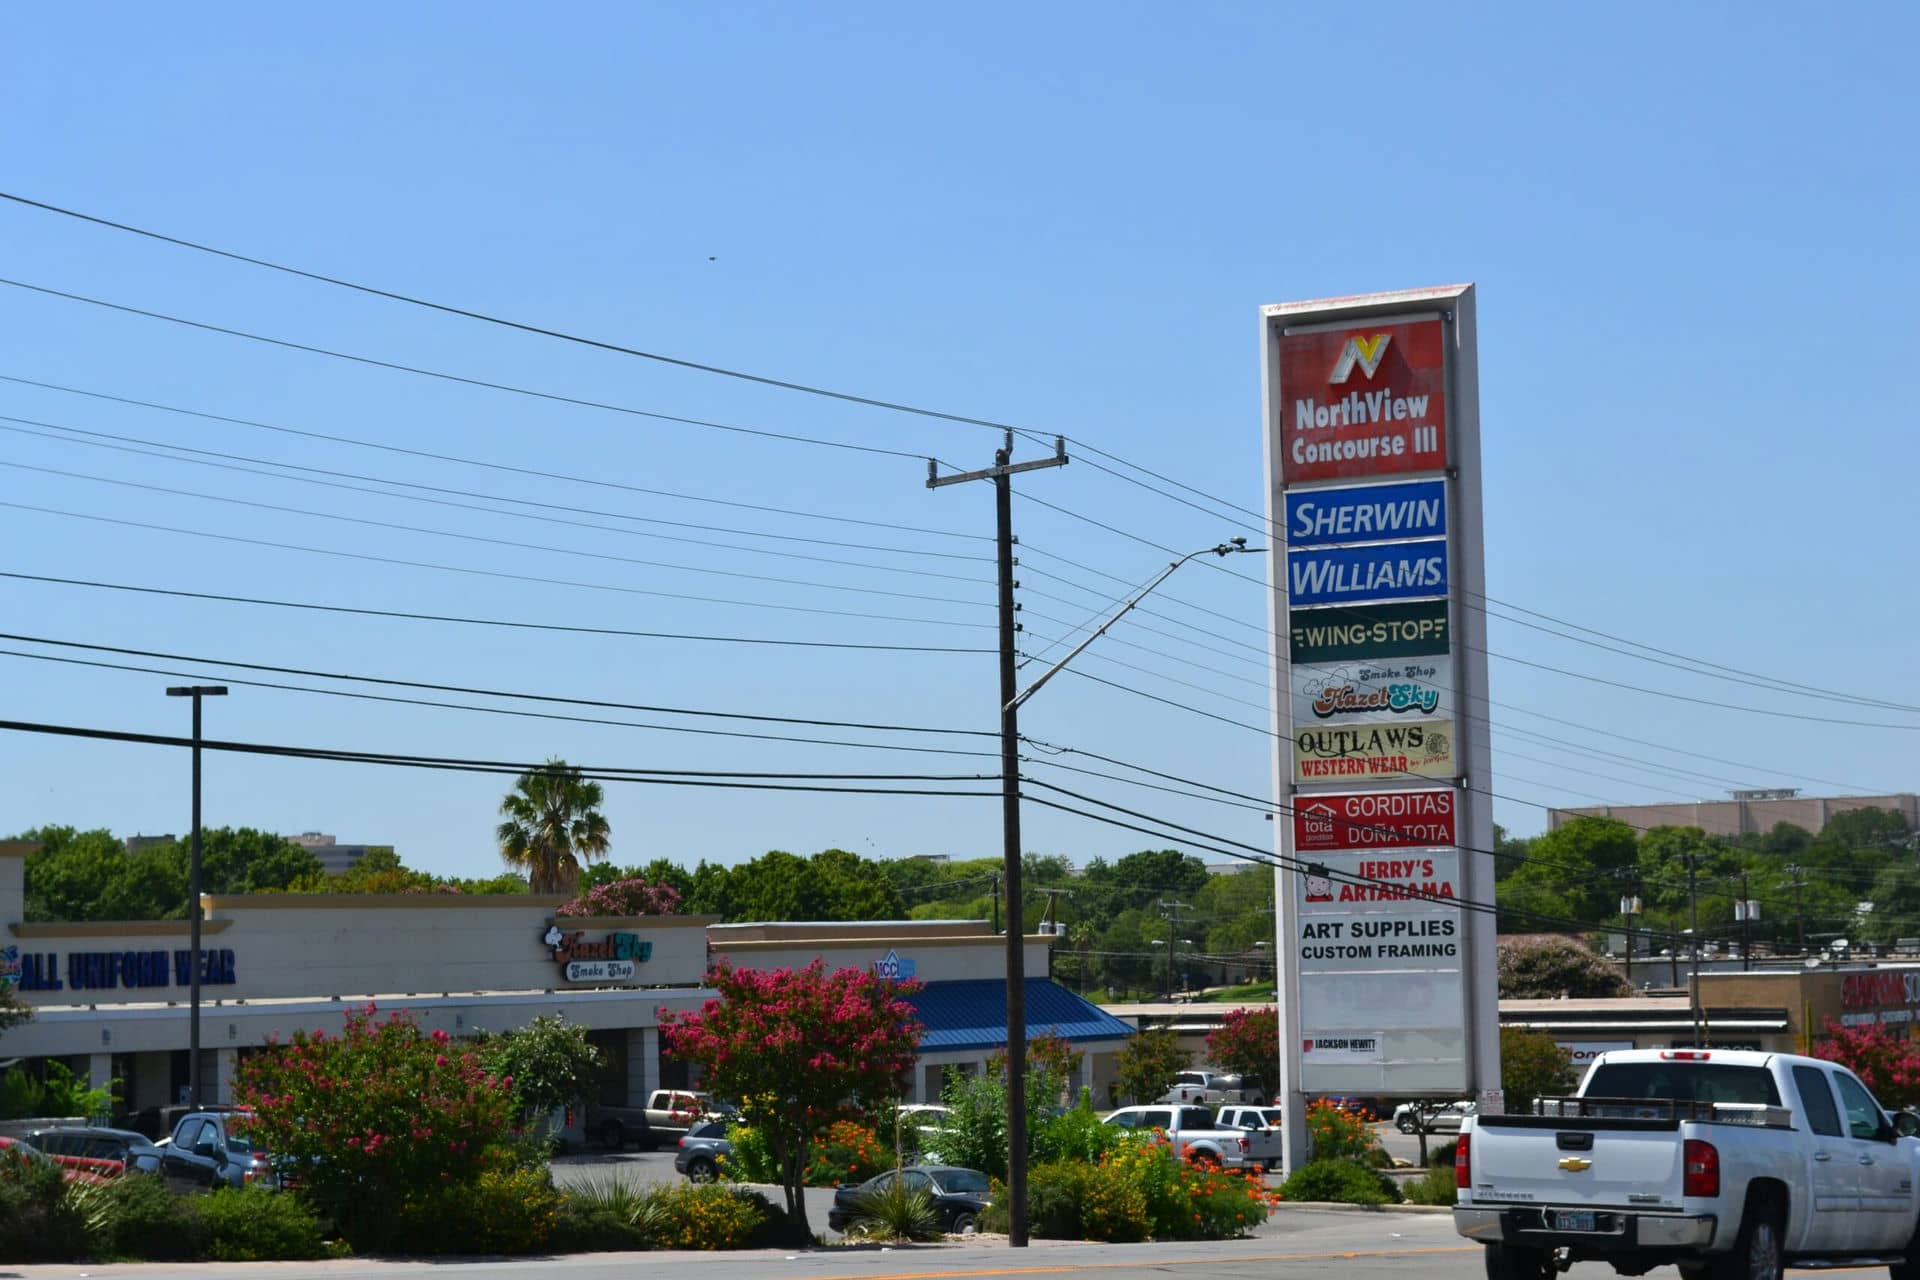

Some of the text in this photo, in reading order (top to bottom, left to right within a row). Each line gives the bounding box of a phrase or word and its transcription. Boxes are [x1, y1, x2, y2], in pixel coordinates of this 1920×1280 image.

[1295, 388, 1428, 429] NorthView
[1292, 426, 1437, 464] Concourse III
[1293, 499, 1439, 537] SHERWIN
[1292, 557, 1442, 595] WILLIAMS
[1359, 666, 1436, 682] Smoke Shop
[1313, 684, 1438, 716] Hazel Sky
[1298, 726, 1424, 756] OUTLAWS
[1301, 757, 1365, 776] WESTERN
[1368, 756, 1408, 773] WEAR
[1345, 794, 1450, 817] GORDITAS
[1403, 824, 1449, 841] TOTA
[1359, 859, 1434, 879] JERRY'S
[1339, 882, 1454, 902] ARTARAMA
[1302, 920, 1455, 939] ART SUPPLIES
[1302, 943, 1456, 959] CUSTOM FRAMING
[19, 953, 63, 991] ALL
[68, 951, 169, 990] UNIFORM
[571, 963, 632, 979] Smoke Shop
[1315, 1039, 1376, 1049] JACKSON HEWITT
